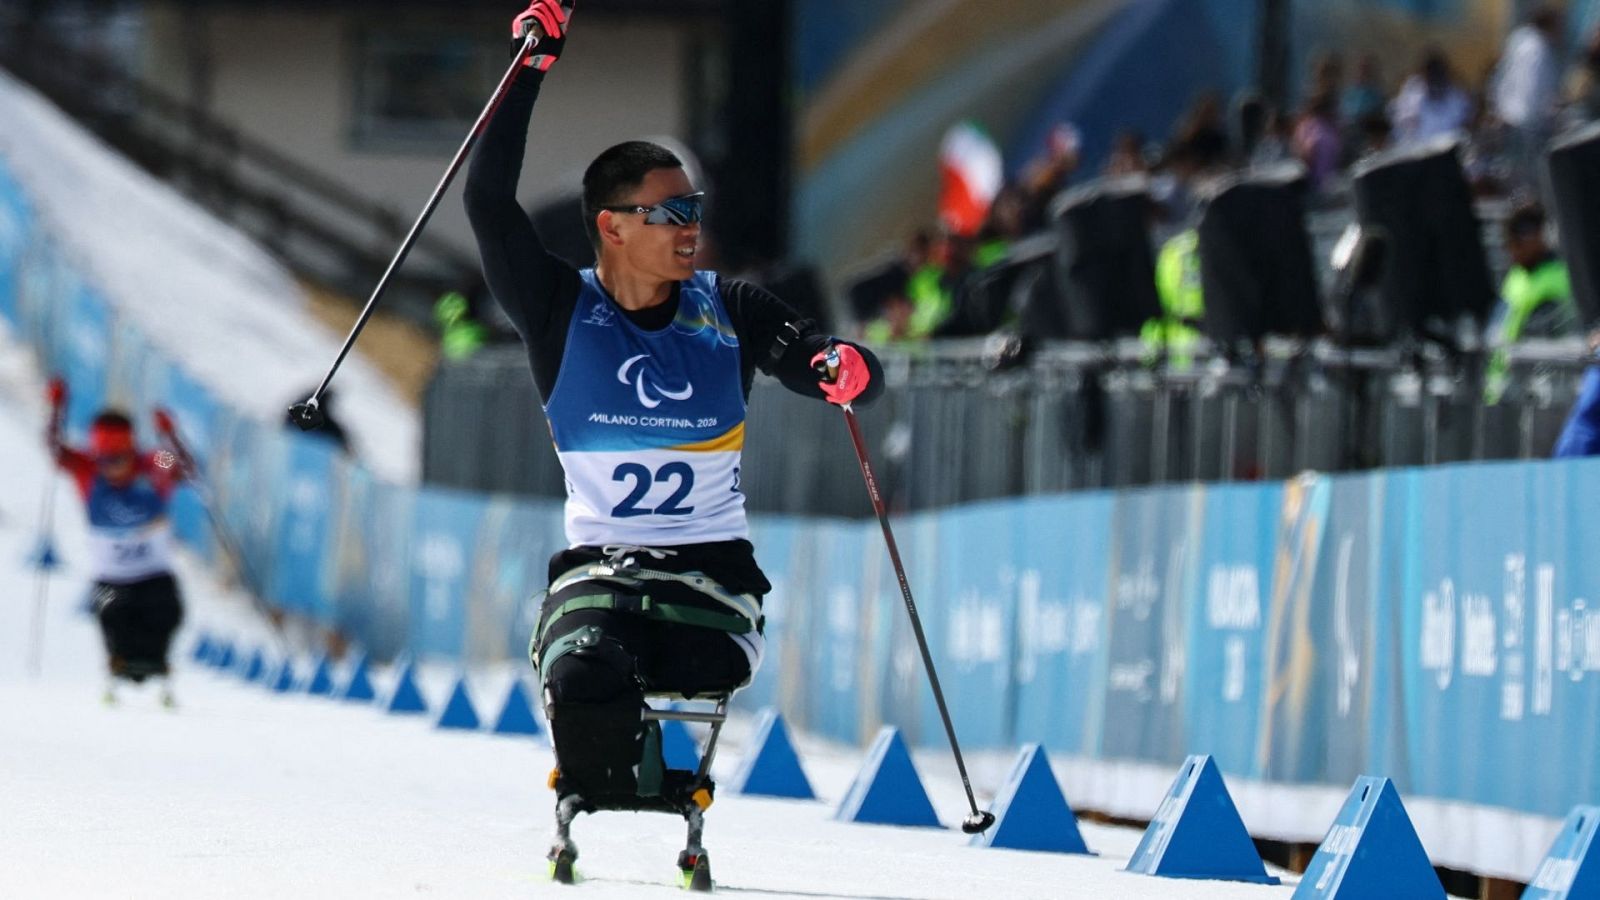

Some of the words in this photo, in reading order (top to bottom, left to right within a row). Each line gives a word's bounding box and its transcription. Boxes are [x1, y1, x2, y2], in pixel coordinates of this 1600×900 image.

[589, 412, 638, 426] MILANO
[640, 417, 695, 428] CORTINA
[697, 418, 718, 428] 2026
[611, 461, 694, 518] 22
